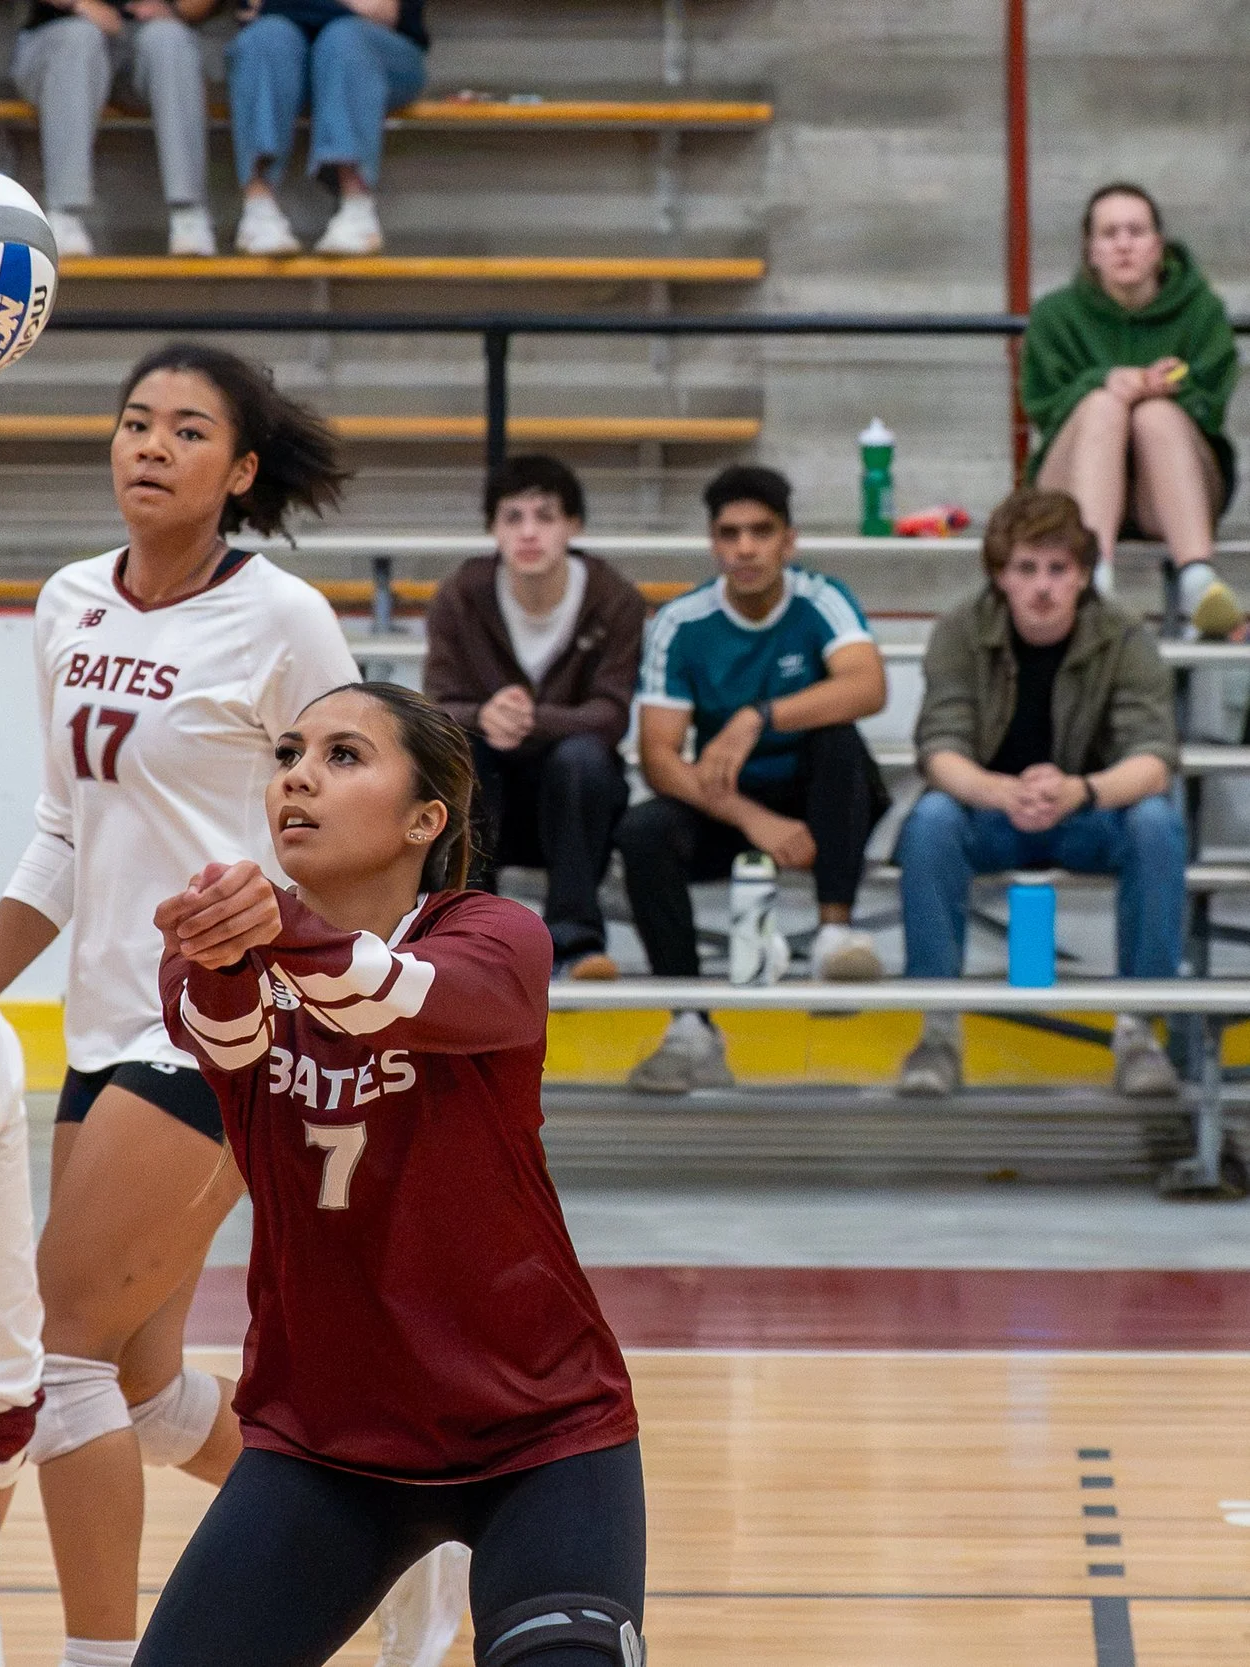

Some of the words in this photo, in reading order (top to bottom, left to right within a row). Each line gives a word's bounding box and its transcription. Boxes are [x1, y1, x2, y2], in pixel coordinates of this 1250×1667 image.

[63, 653, 180, 701] BATES
[67, 703, 141, 784] 17
[269, 1049, 417, 1111] BATES
[303, 1121, 367, 1210] 7
